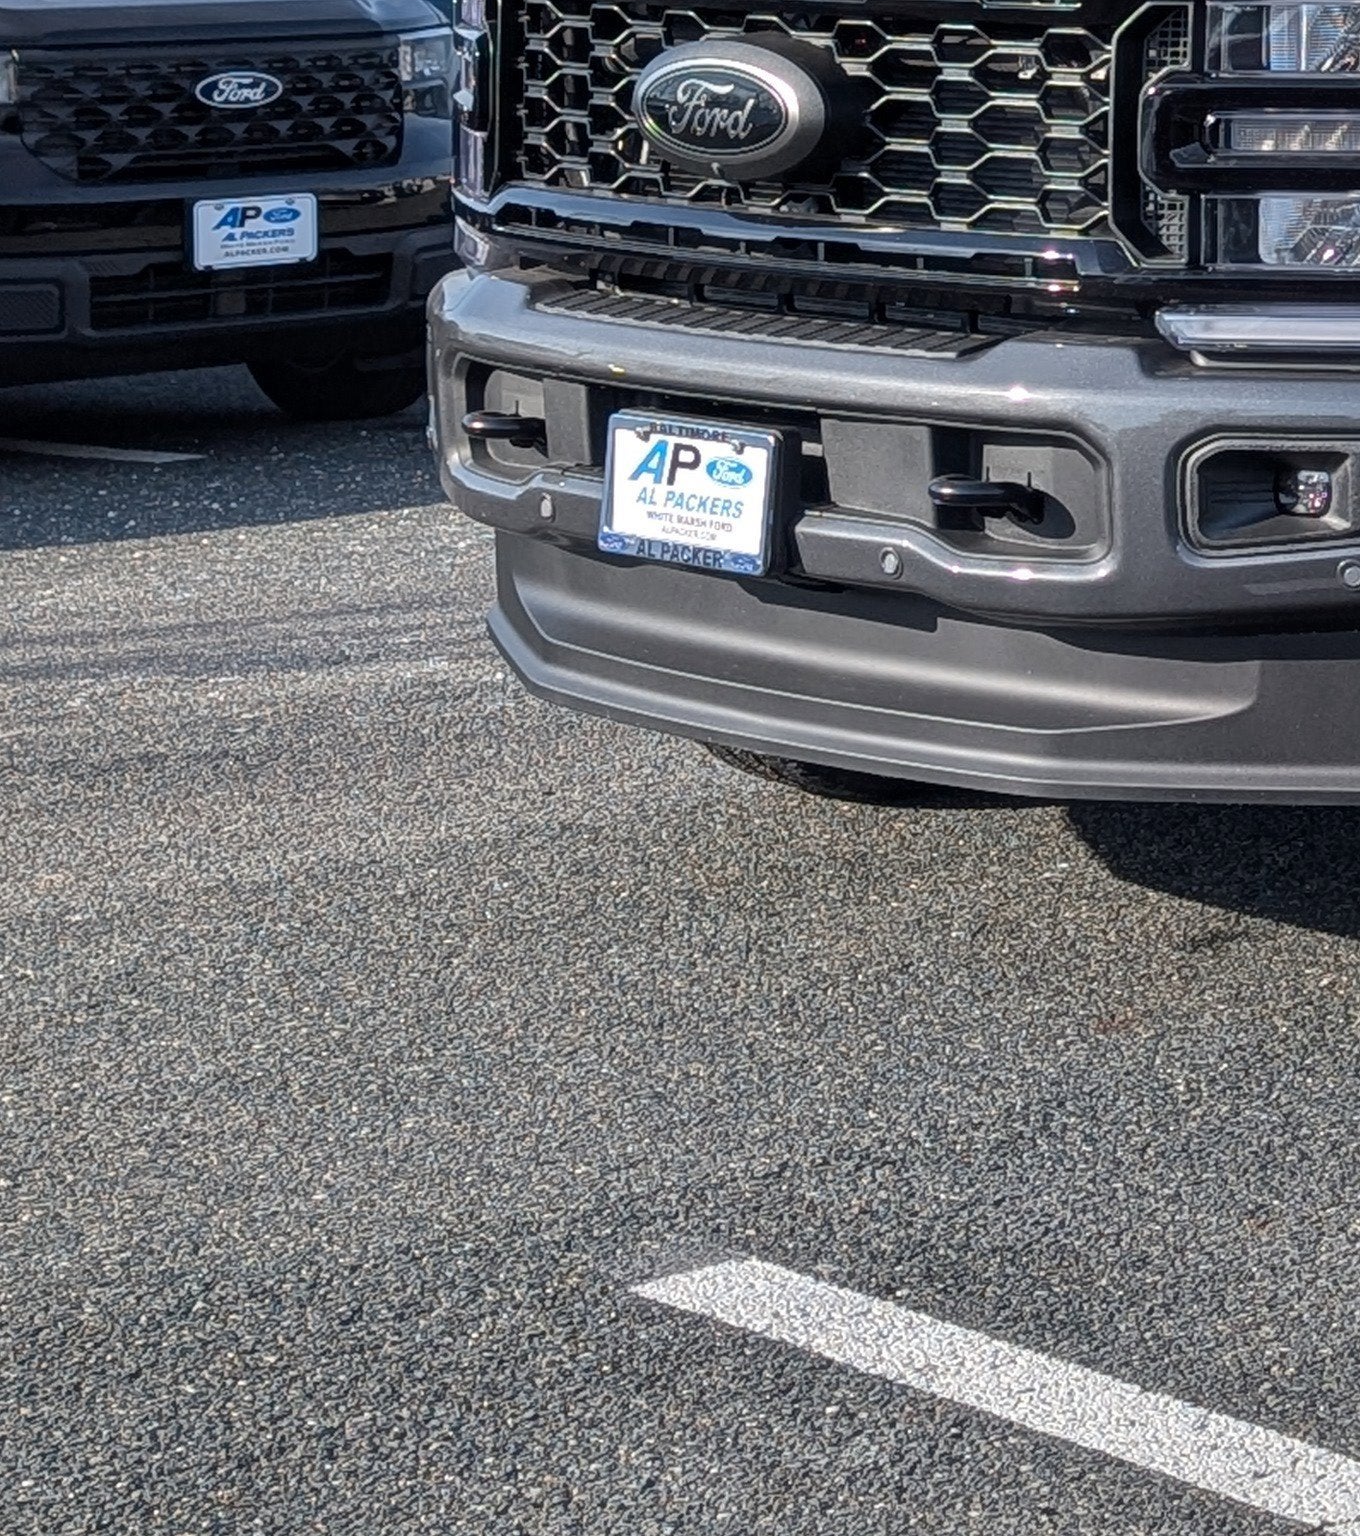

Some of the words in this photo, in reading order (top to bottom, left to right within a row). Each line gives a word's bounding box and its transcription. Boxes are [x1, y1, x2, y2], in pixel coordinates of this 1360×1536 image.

[213, 77, 266, 102] Ford
[667, 78, 758, 140] Ford
[212, 206, 262, 230] AP
[240, 227, 295, 240] PACKERS
[649, 422, 731, 442] BALTIMORE
[627, 439, 702, 486] AP
[712, 461, 747, 484] Ford
[636, 486, 658, 506] AL
[663, 490, 744, 519] PACKERS
[636, 540, 656, 558] AL
[661, 543, 724, 568] PACKER
